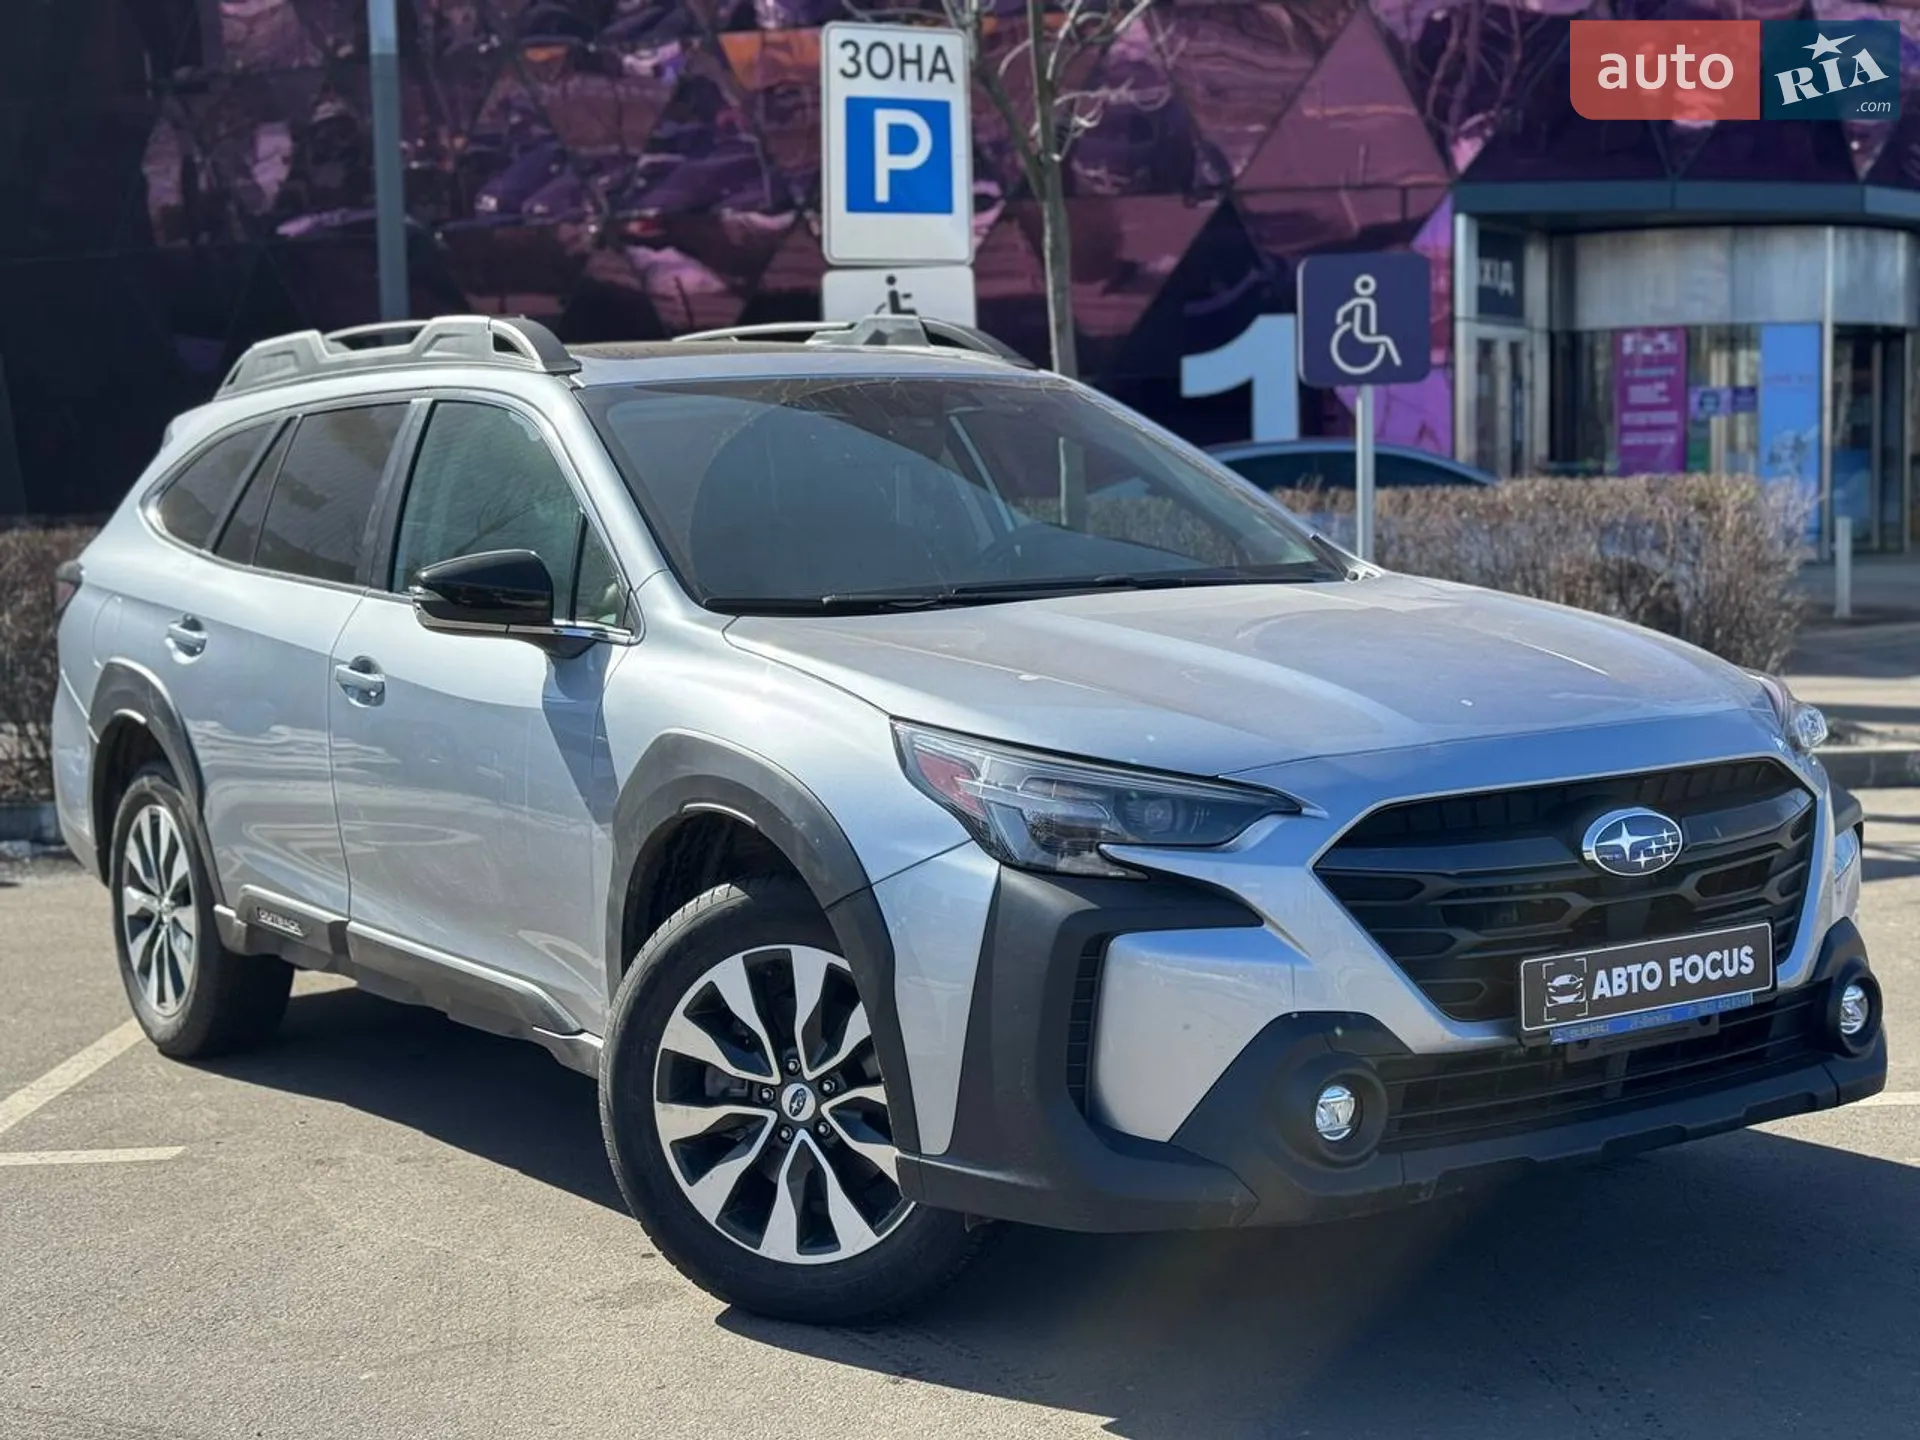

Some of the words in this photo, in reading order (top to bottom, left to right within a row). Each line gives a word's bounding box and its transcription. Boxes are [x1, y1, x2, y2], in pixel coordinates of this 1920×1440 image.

[839, 40, 955, 84] ЗОНА
[874, 108, 933, 203] P
[1181, 314, 1299, 441] 1
[1592, 961, 1663, 1000] АВТО
[1669, 945, 1755, 987] FOCUS
